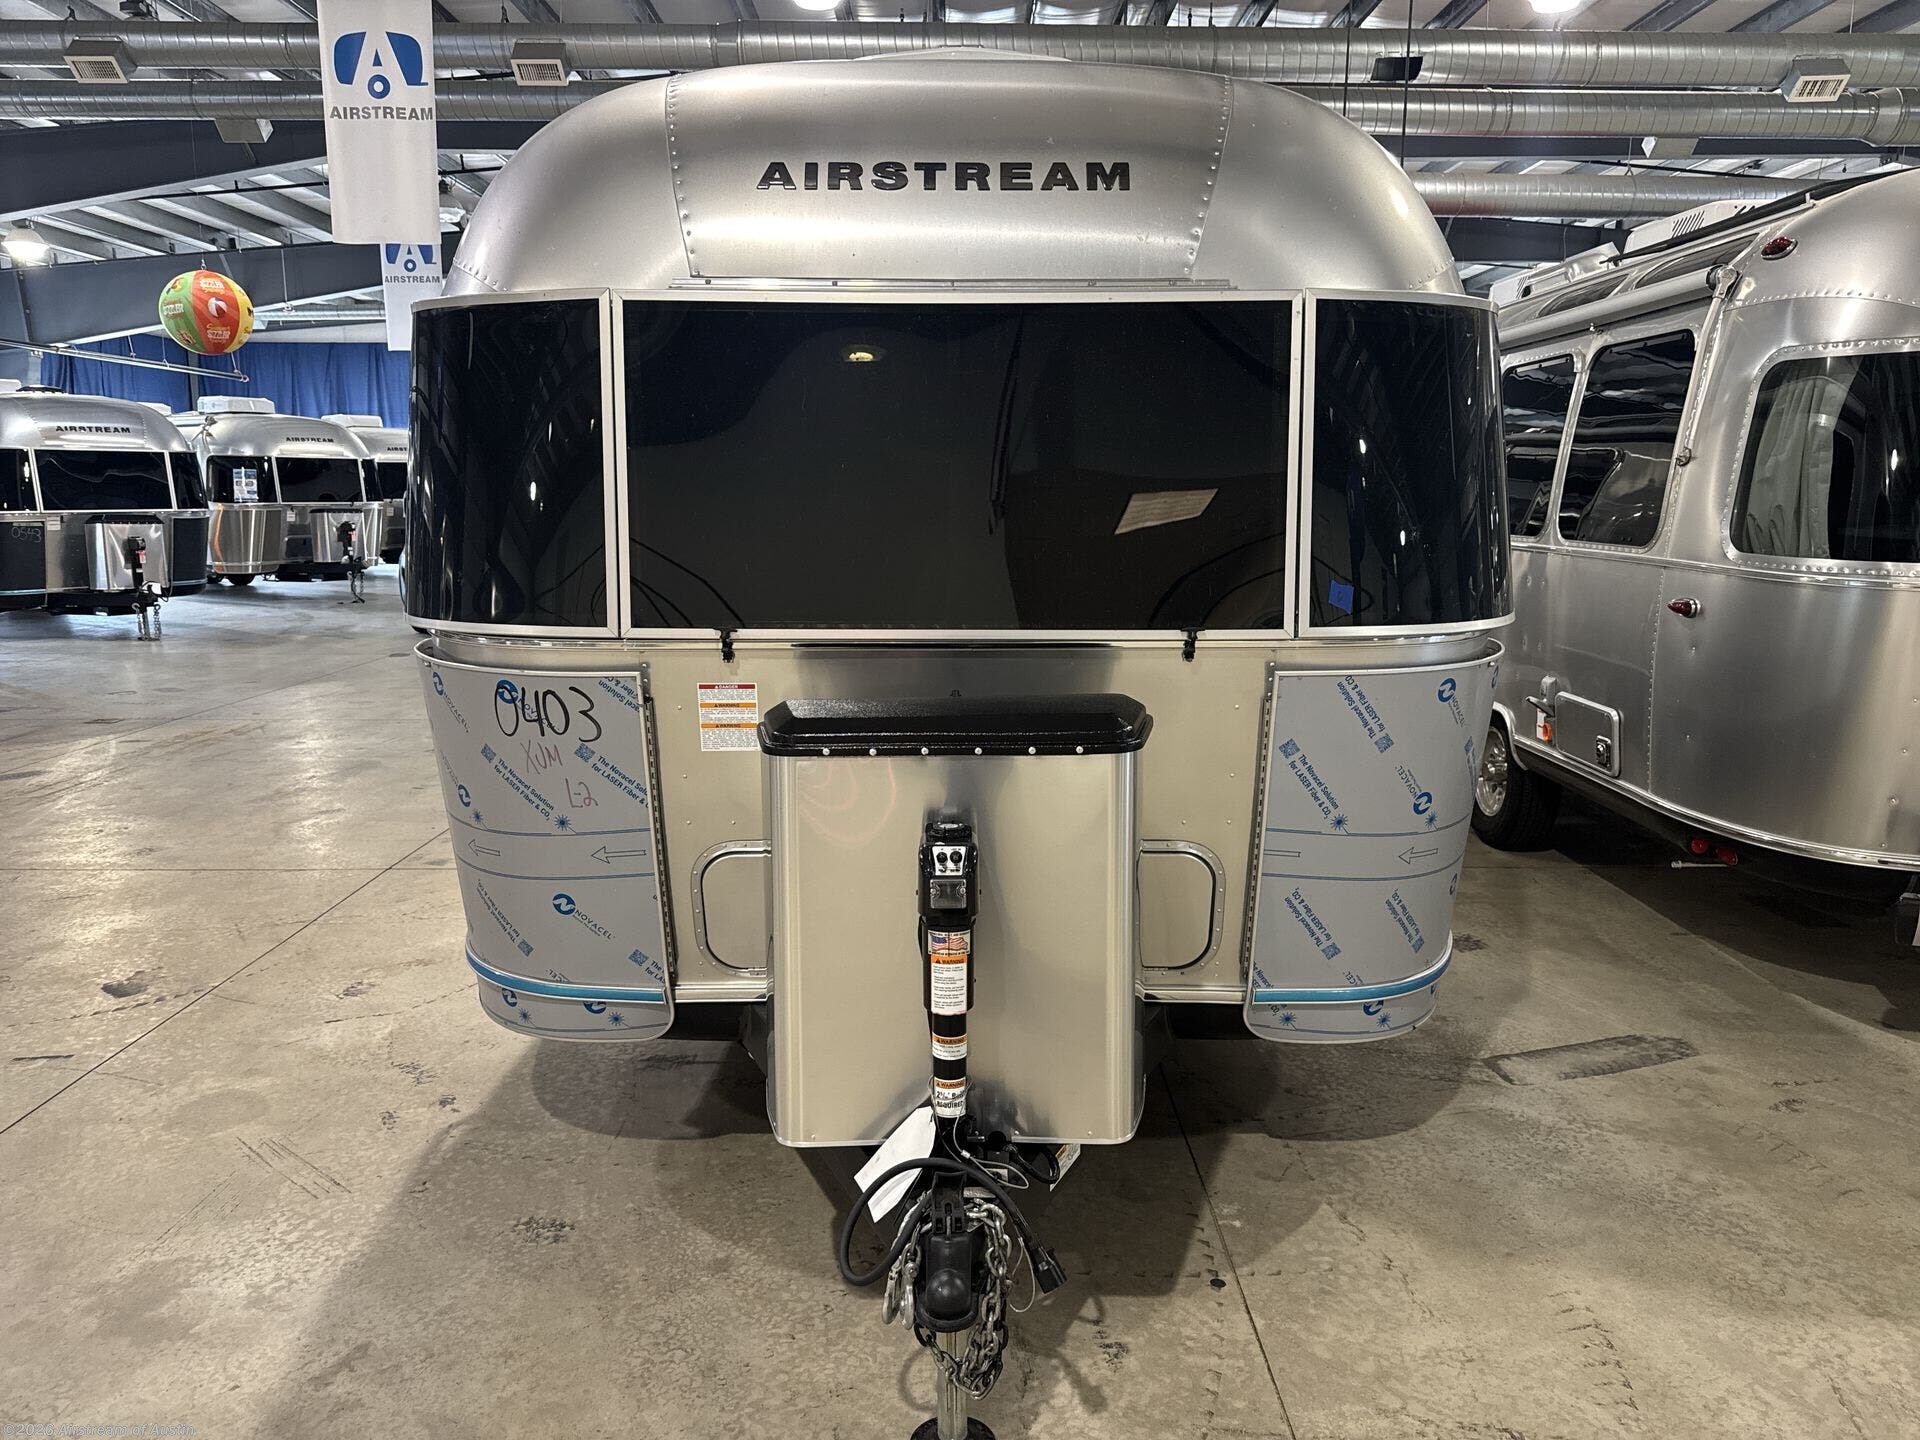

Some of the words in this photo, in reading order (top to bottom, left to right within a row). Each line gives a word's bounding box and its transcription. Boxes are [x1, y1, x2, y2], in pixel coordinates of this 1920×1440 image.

[330, 105, 433, 121] AIRSTREAM
[756, 161, 1131, 192] AIRSTREAM
[384, 275, 440, 284] AIRSTREAM
[55, 425, 131, 434] AIRSTREAM
[598, 680, 626, 703] Solution
[1336, 681, 1356, 707] Solution
[1355, 690, 1369, 706] Fiber
[495, 686, 602, 742] 0403
[1350, 704, 1370, 729] Novacel
[1364, 703, 1381, 724] LASER
[591, 762, 602, 773] for
[601, 770, 624, 789] LASER
[622, 786, 640, 800] Fiber
[597, 755, 610, 768] The
[609, 764, 636, 786] Novacel
[1288, 760, 1298, 770] for
[1294, 768, 1312, 790] LASER
[1308, 786, 1321, 803] Fiber
[1298, 754, 1308, 767] The
[1305, 764, 1326, 788] Novacel
[1320, 785, 1340, 810] Solution
[1397, 765, 1418, 801] NOVACEL
[494, 764, 502, 774] for
[502, 772, 521, 793] LASER
[519, 790, 535, 806] Fiber
[498, 758, 509, 771] The
[508, 768, 531, 791] Novacel
[530, 788, 555, 811] Solution
[574, 909, 613, 940] NOVACEL
[644, 966, 655, 977] for
[651, 960, 662, 972] The
[941, 1080, 965, 1089] WARNING
